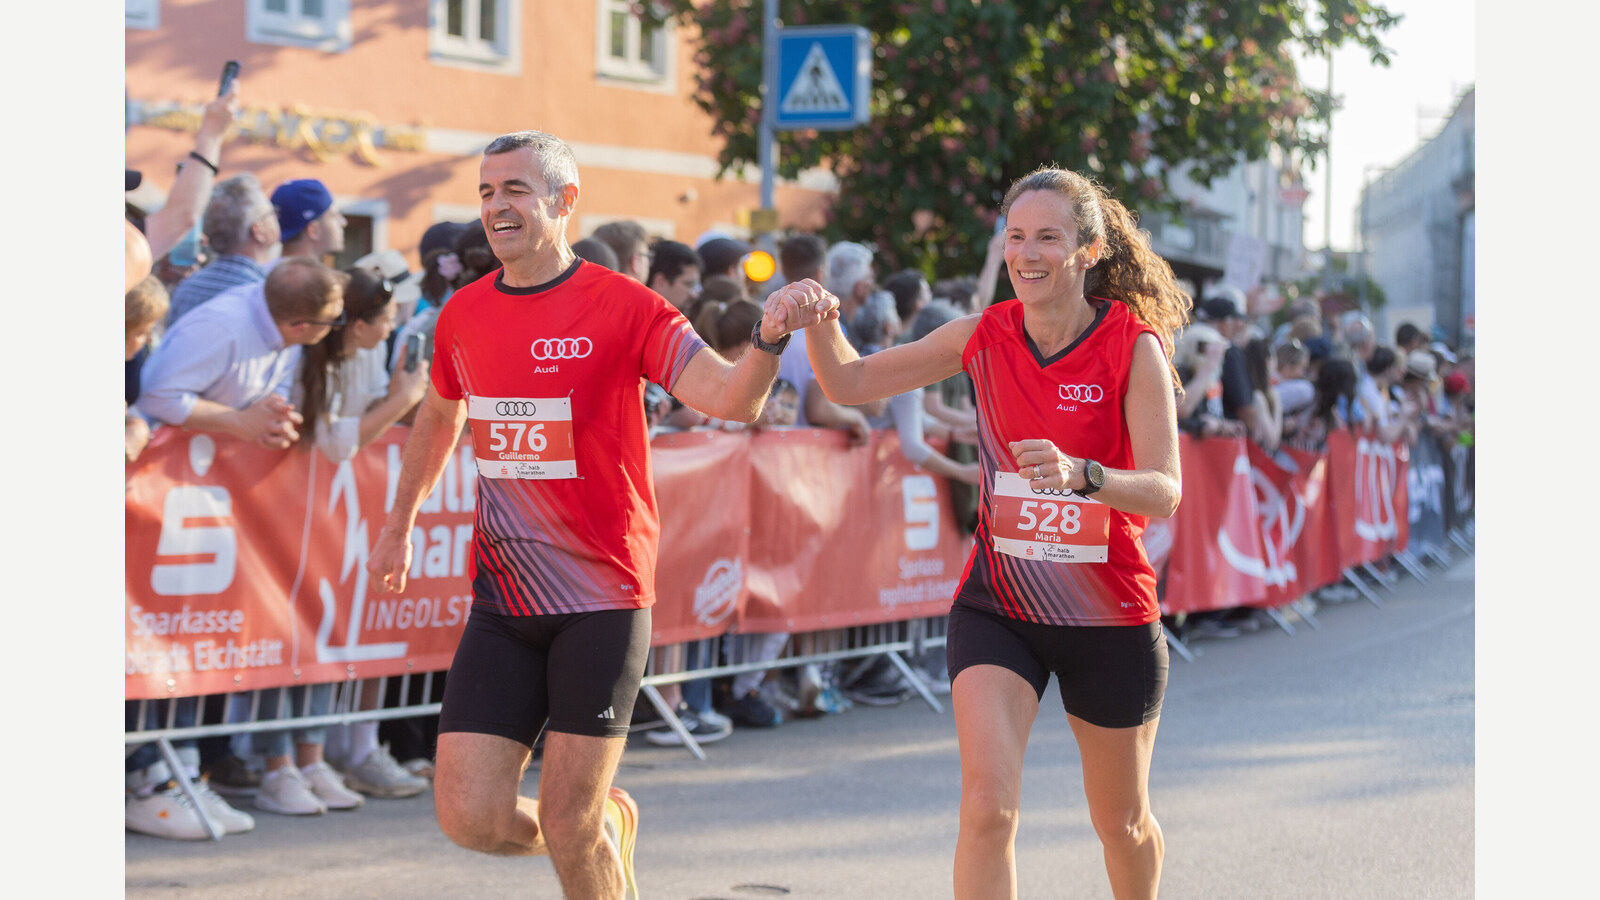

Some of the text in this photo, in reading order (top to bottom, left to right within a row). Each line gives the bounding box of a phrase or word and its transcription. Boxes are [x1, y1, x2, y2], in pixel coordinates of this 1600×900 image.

[534, 365, 559, 374] Audi
[1056, 404, 1078, 412] Audi
[489, 423, 548, 452] 576
[498, 452, 540, 461] Guillermo
[1017, 501, 1081, 535] 528
[1035, 532, 1061, 542] Maria
[129, 605, 244, 641] Sparkasse
[194, 638, 284, 671] Eichstätt
